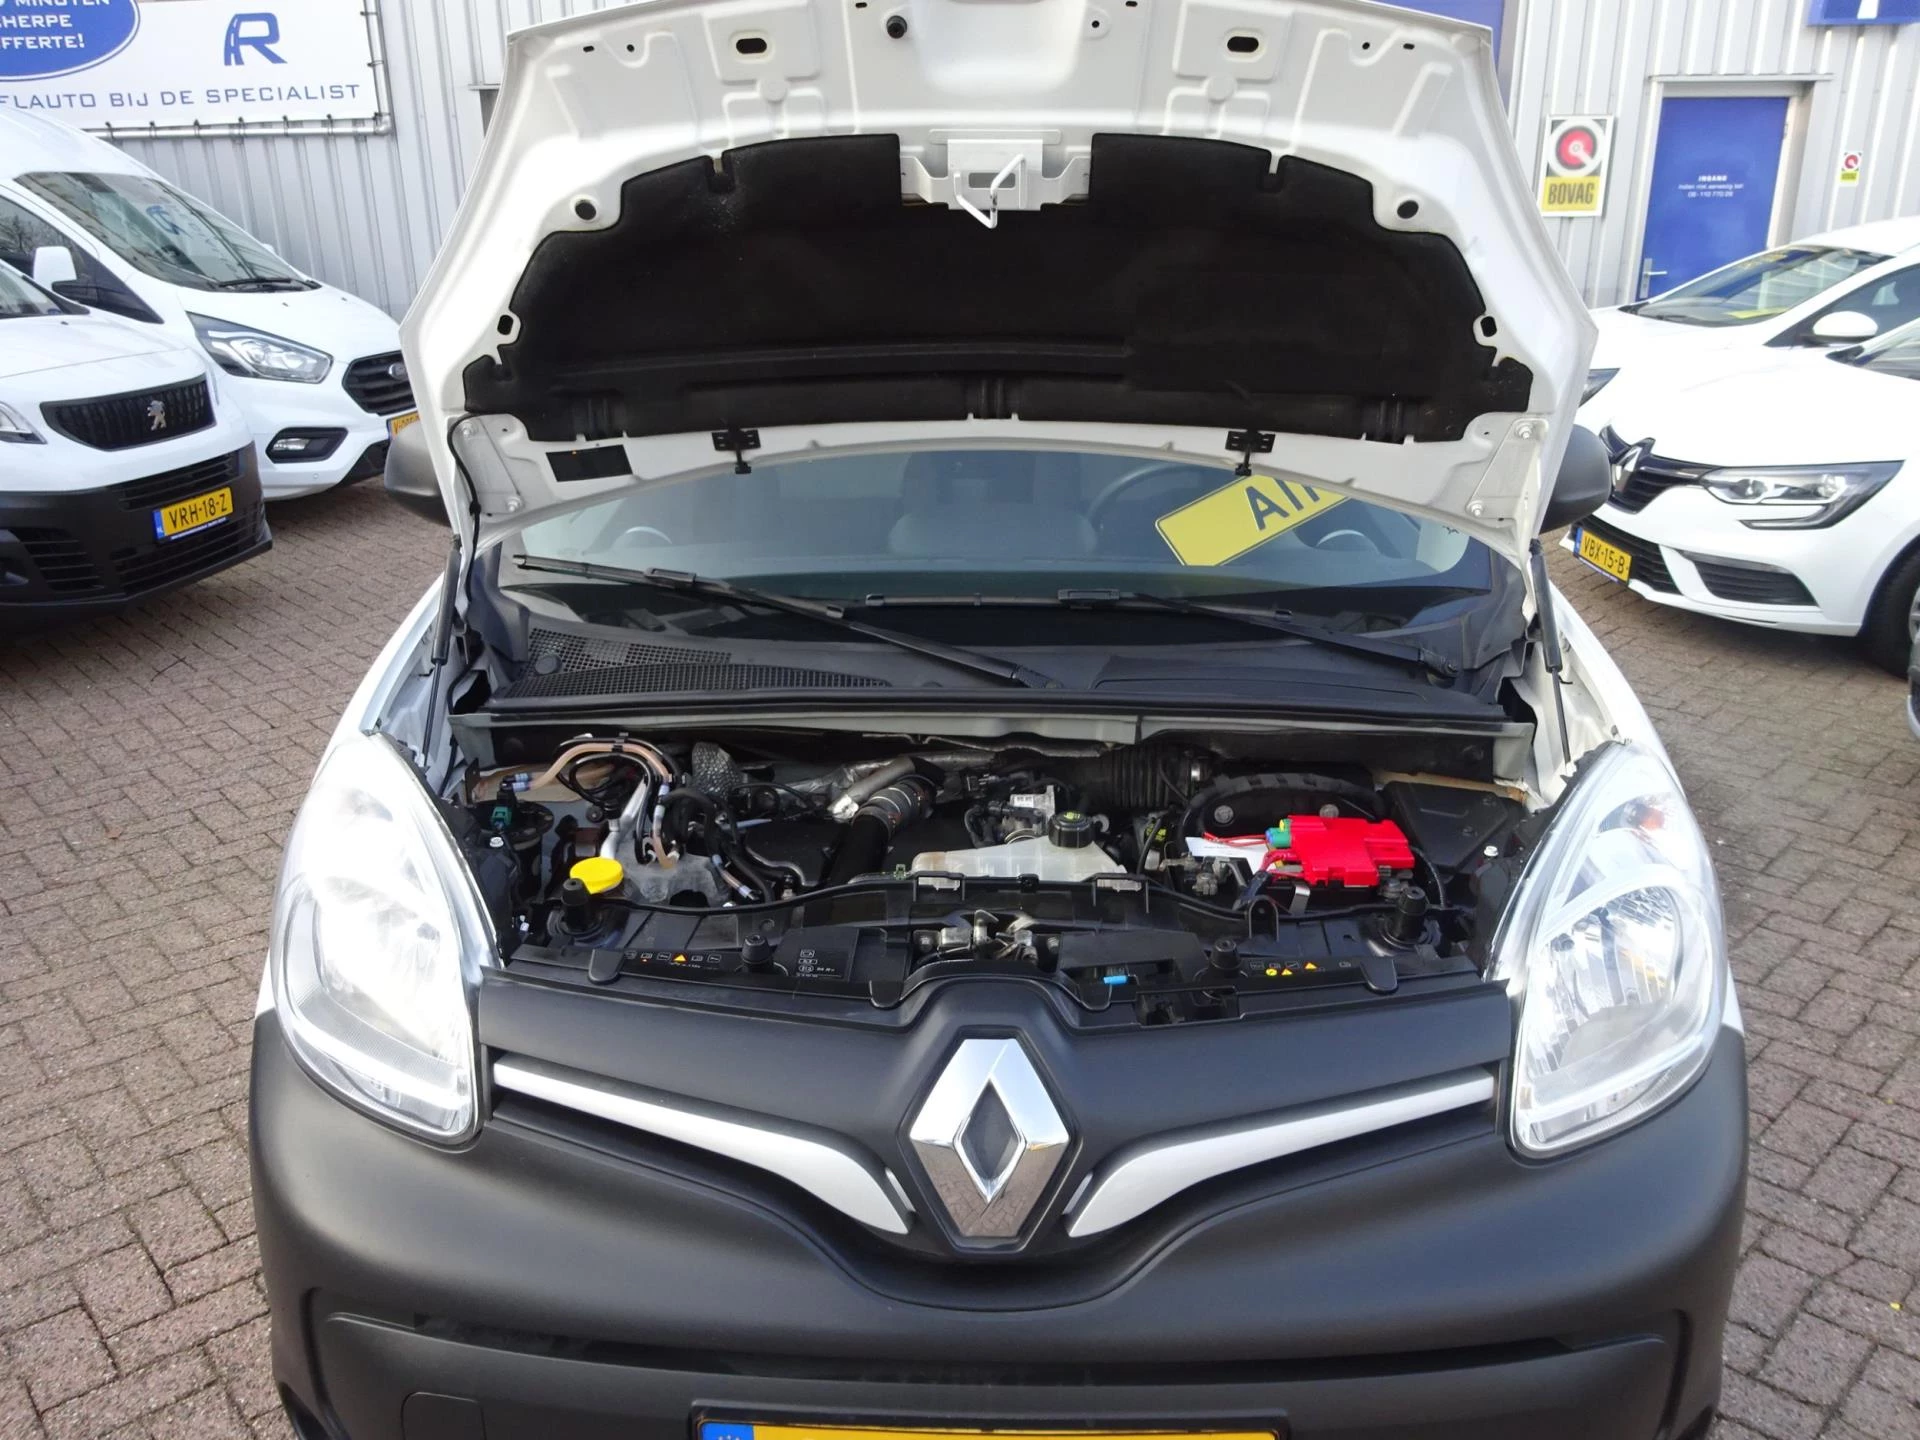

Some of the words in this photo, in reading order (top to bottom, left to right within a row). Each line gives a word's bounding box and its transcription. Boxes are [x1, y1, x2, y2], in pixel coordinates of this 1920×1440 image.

[0, 14, 73, 28] HERPE
[109, 93, 149, 107] BIJ
[160, 90, 194, 105] DE
[206, 84, 360, 104] SPECIALIST
[1548, 183, 1595, 205] BOVAG
[169, 494, 227, 529] VRH-18-Z
[1584, 535, 1625, 574] VBX-15-B
